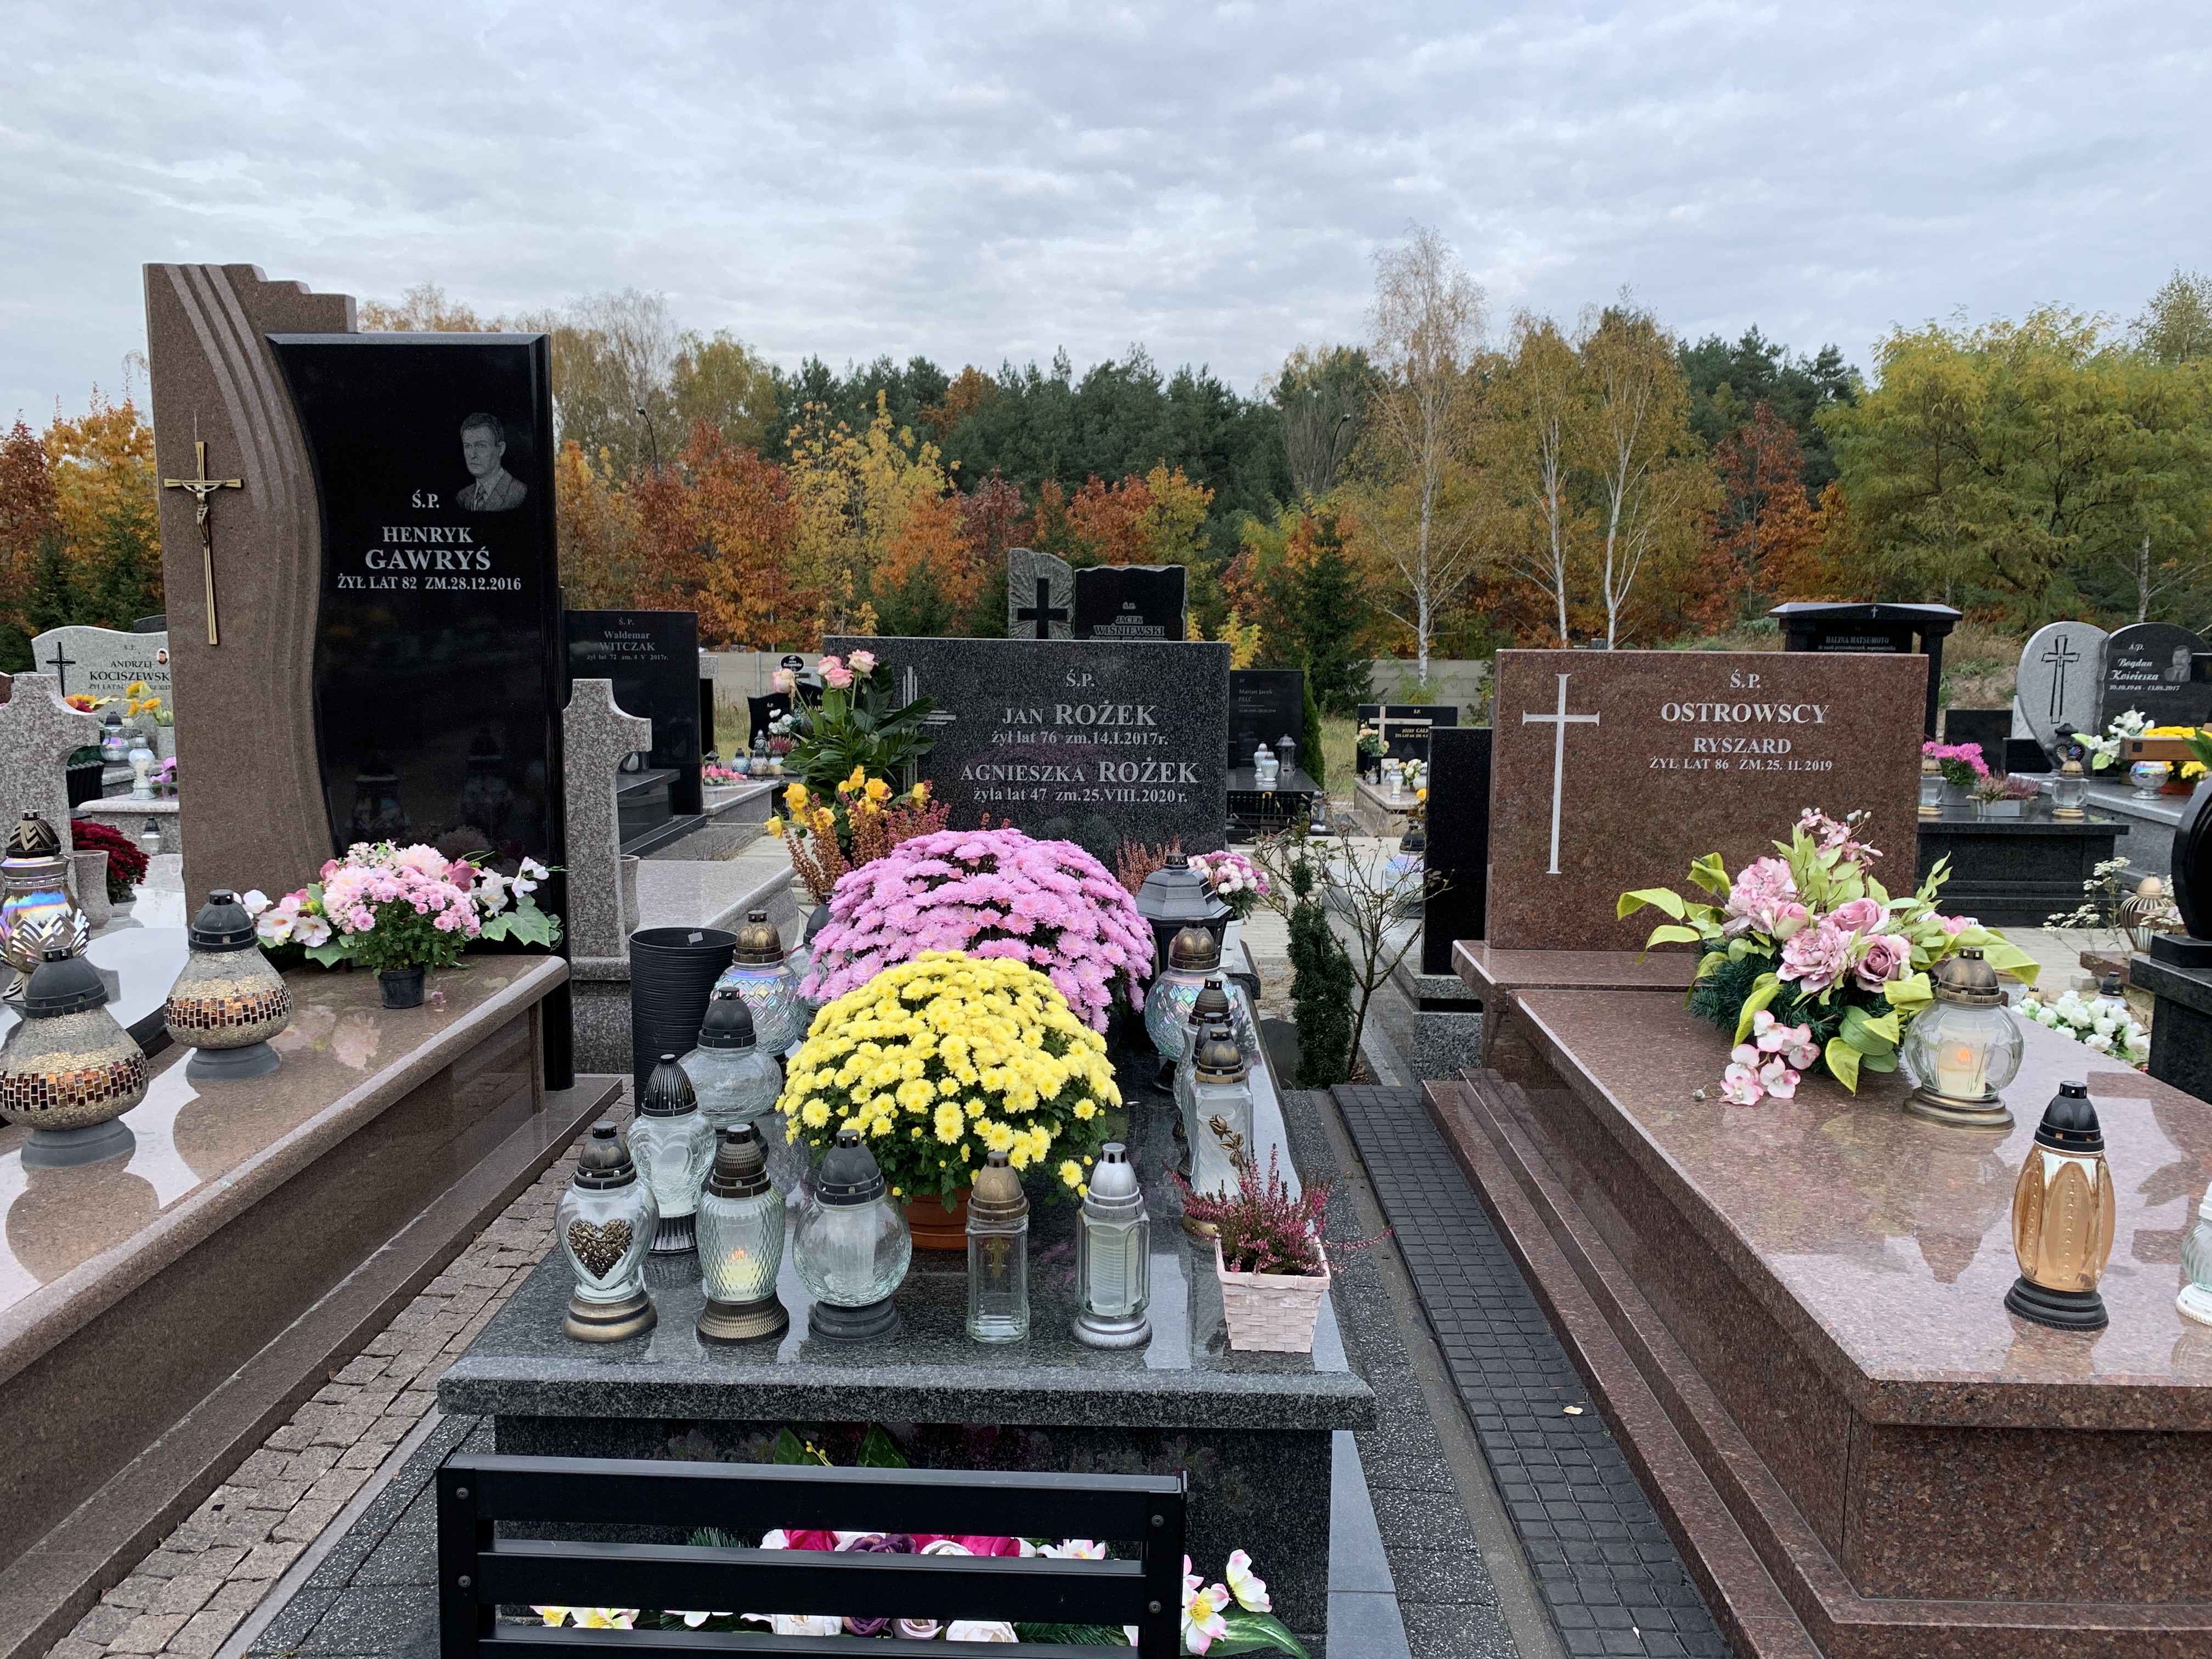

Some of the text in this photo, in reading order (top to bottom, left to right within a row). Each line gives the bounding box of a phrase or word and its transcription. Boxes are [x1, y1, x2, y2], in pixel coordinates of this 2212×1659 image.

[382, 526, 473, 543] HENRYK
[365, 546, 491, 570] GAWRYŚ
[337, 573, 366, 589] ŻYŁ
[369, 577, 398, 589] LAT
[402, 577, 417, 590] 82
[1115, 616, 1143, 624] JACEK
[603, 630, 651, 639] Waldemar
[1093, 623, 1165, 636] WIŚNIEWSKI
[599, 642, 656, 651] WITCZAK
[111, 661, 152, 669] ANDRZEJ
[2118, 658, 2153, 669] Bogdan
[89, 671, 171, 681] KOCISZEWSK
[2109, 669, 2159, 681] Kościesza
[1002, 699, 1157, 726] JAN ROŻEK
[1661, 702, 1830, 724] OSTROWSCY
[991, 730, 1014, 745] żył
[1017, 731, 1035, 744] lat
[1041, 731, 1057, 744] 76
[1693, 737, 1792, 754] RYSZARD
[1649, 755, 1678, 769] ŻYŁ
[1684, 758, 1711, 769] LAT
[1715, 759, 1729, 770] 86
[960, 757, 1200, 784] AGNIESZKA ROŻEK
[973, 787, 1003, 803] żyła
[1008, 787, 1026, 801] lat
[1030, 788, 1047, 802] 47
